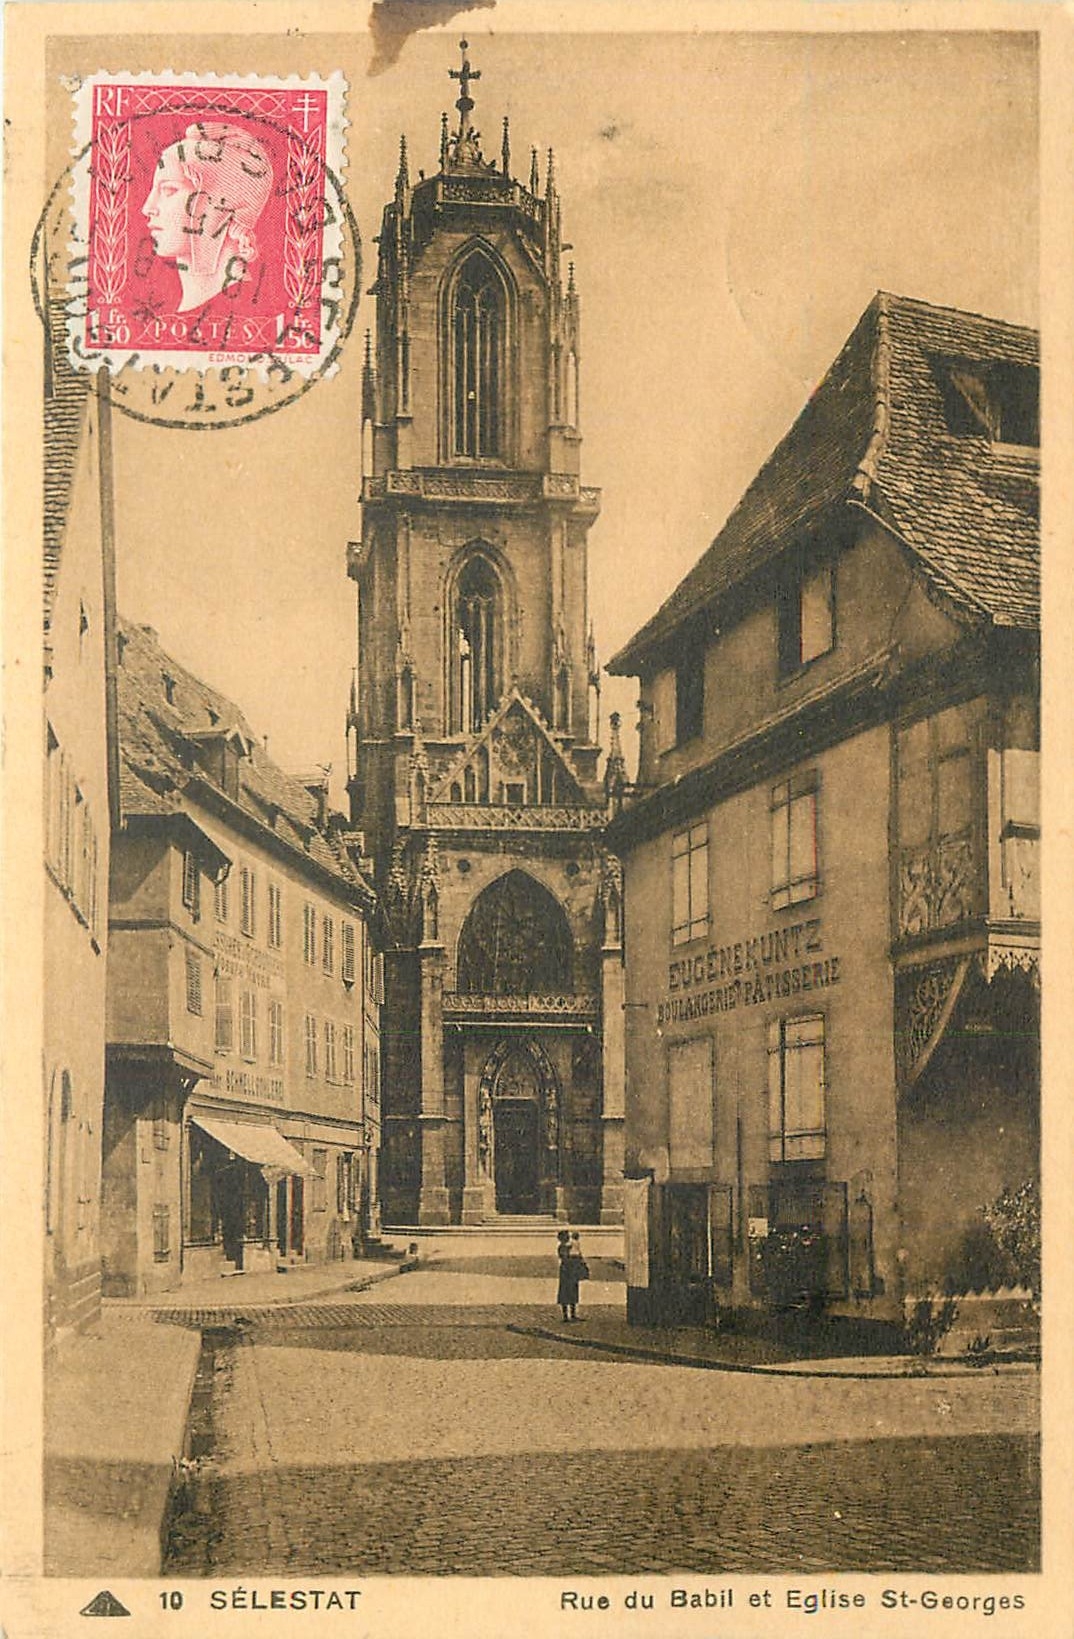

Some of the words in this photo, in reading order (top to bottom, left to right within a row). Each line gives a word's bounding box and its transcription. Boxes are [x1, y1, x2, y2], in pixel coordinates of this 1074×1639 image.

[96, 87, 134, 116] RF
[153, 319, 253, 342] POSTES
[745, 918, 823, 967] KUNTZ
